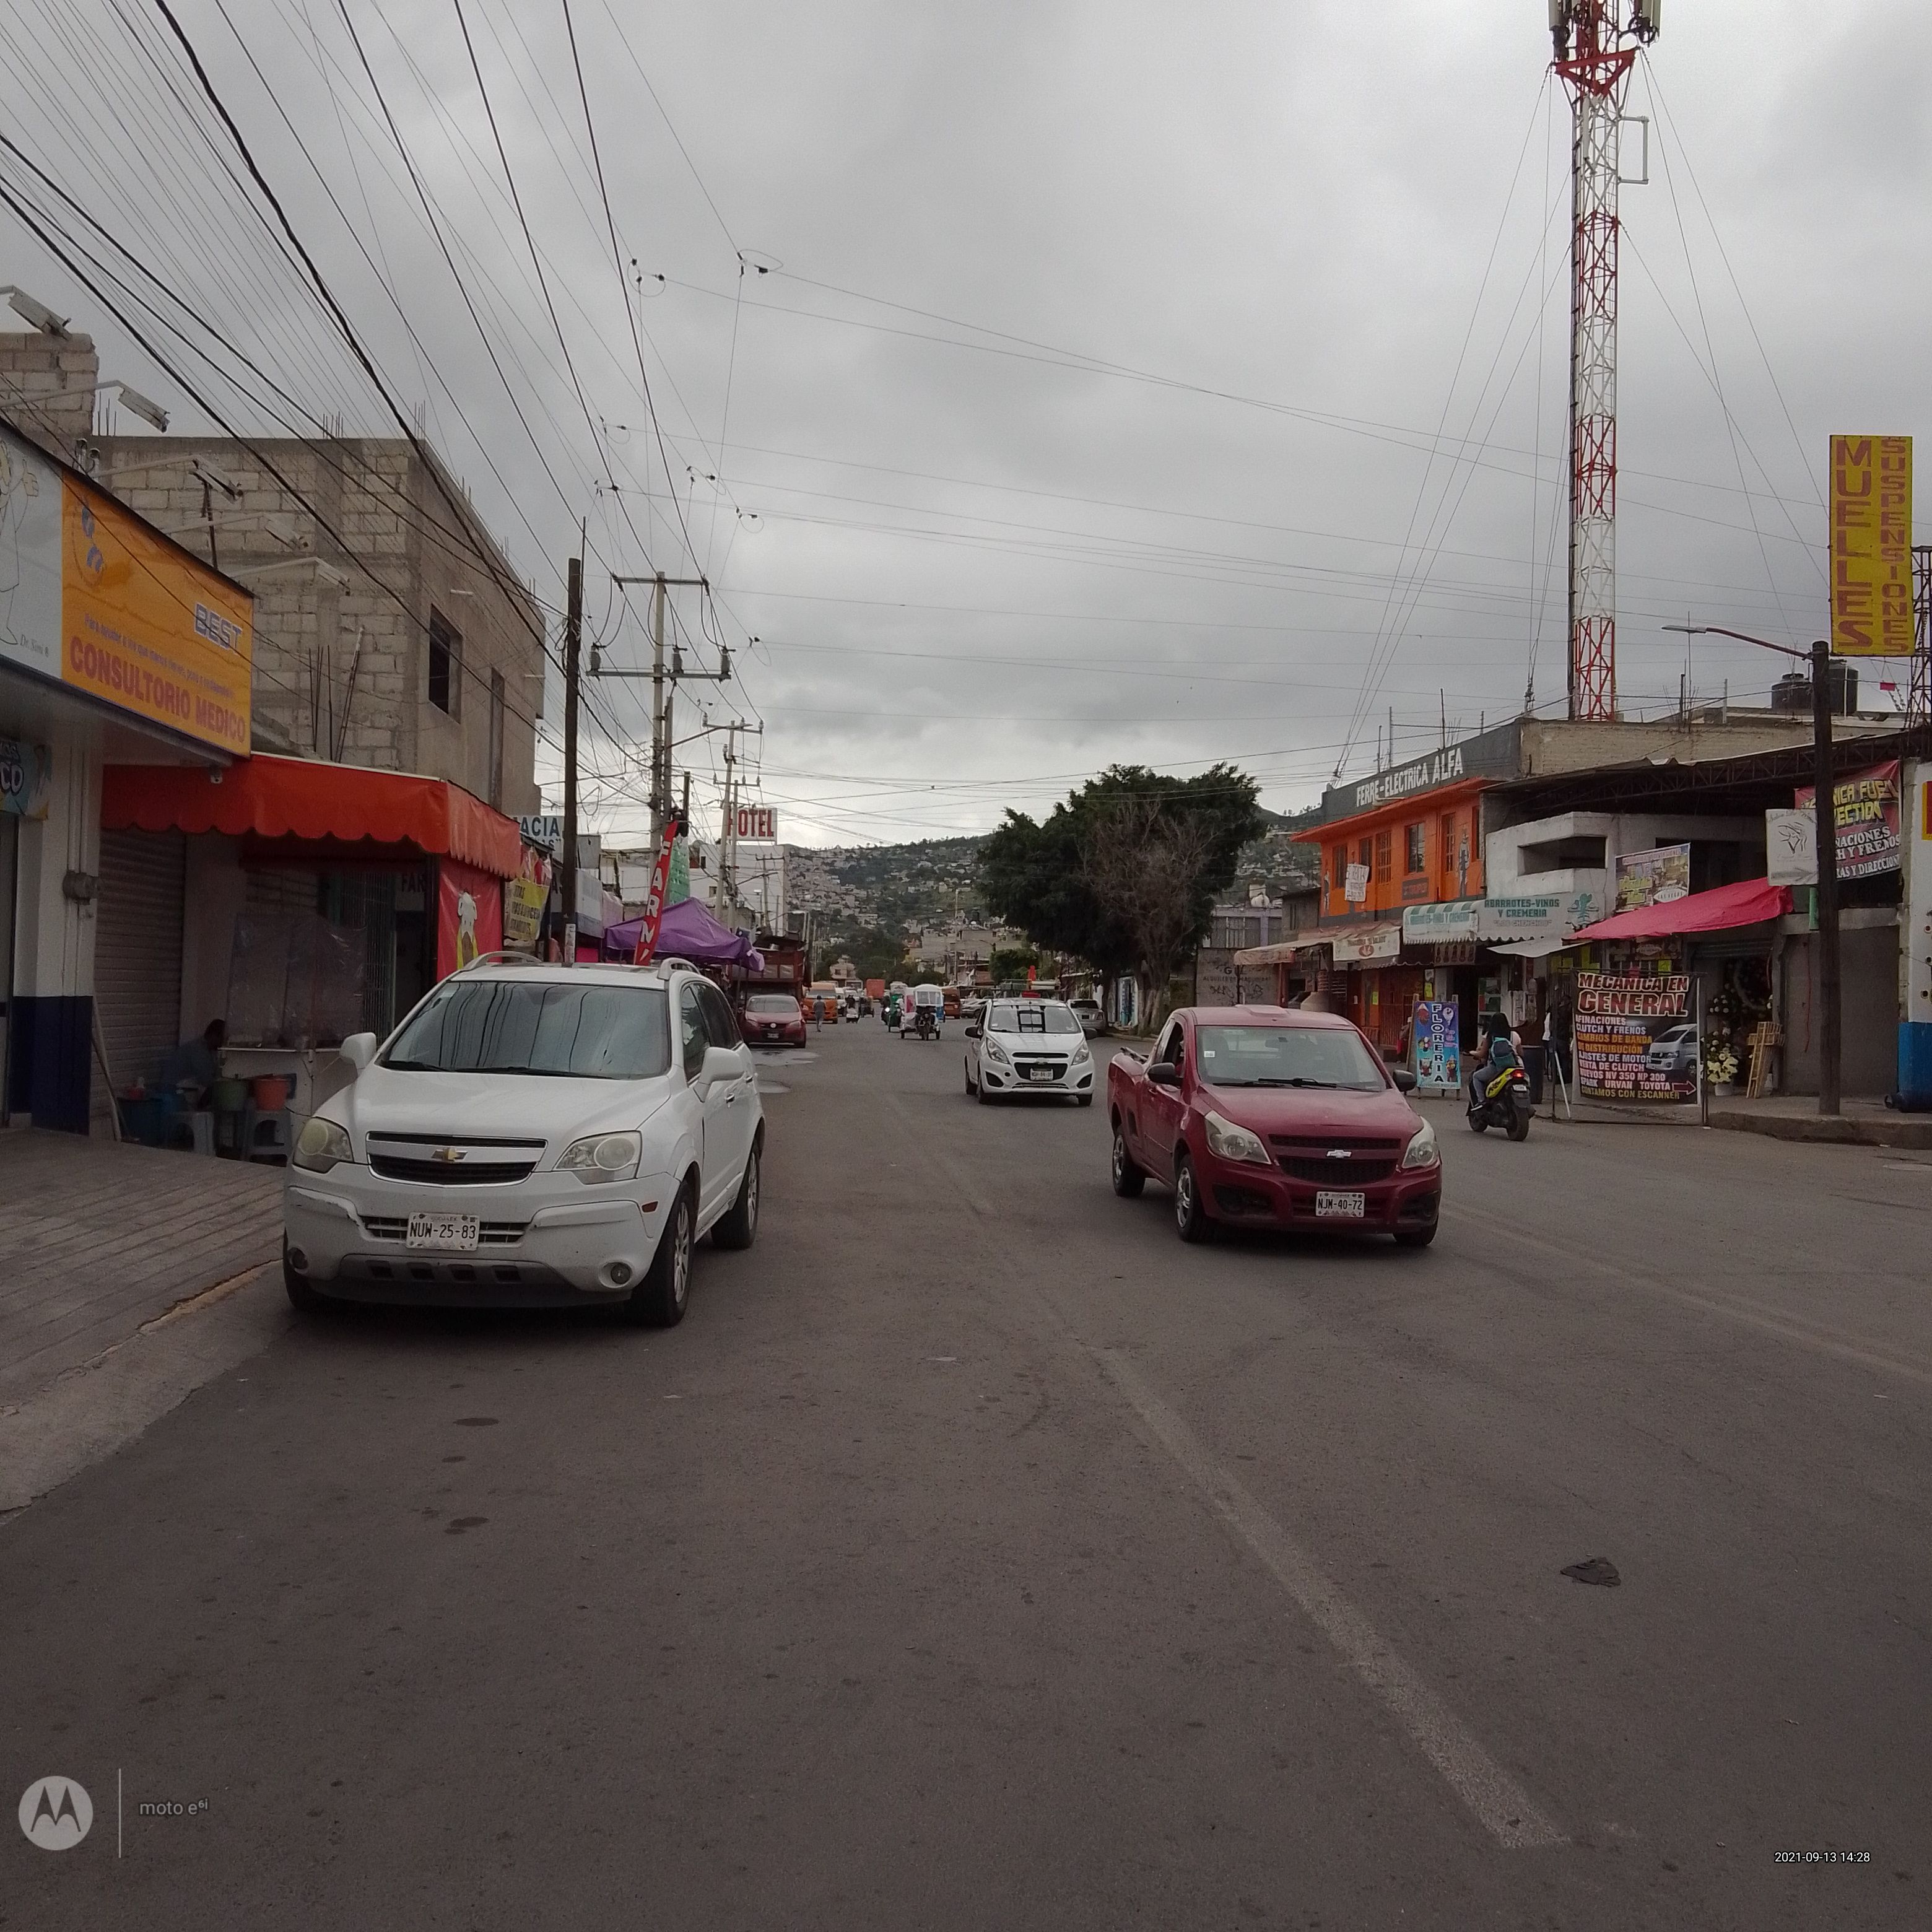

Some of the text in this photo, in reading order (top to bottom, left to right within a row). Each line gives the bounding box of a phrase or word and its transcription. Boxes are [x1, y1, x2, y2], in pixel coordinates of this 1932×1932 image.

[1836, 440, 1873, 648] MUELLES
[1880, 436, 1909, 652] SUSPENSIONES
[194, 602, 243, 655] BEST
[69, 635, 191, 720] CONSULTORIO
[195, 695, 245, 742] MEDICO
[1356, 747, 1464, 807] FERRE-ELECTRICA ALFA
[1834, 801, 1884, 826] ECTION
[729, 809, 774, 837] OTEL
[1847, 846, 1856, 859] Y
[1850, 864, 1858, 877] Y
[1497, 908, 1547, 918] Y CREMERIA
[1577, 972, 1689, 992] MECANICA EN
[1578, 989, 1689, 1017] GENERAL
[1576, 1024, 1647, 1035] CLUTCH Y FRENOS
[1431, 1004, 1445, 1082] FLORERIA
[1612, 1034, 1624, 1043] DE
[1625, 1035, 1653, 1044] BANDA
[1608, 1053, 1621, 1063] DE
[1622, 1053, 1651, 1063] MOTOR
[1598, 1061, 1610, 1071] DE
[1611, 1061, 1645, 1072] CLUTCH
[1605, 1071, 1617, 1080] NV
[1619, 1071, 1635, 1081] 350
[1637, 1073, 1648, 1081] NP
[1650, 1073, 1666, 1081] 300
[1604, 1079, 1633, 1090] URVAN
[1640, 1081, 1671, 1090] TOYOTA
[1617, 1089, 1635, 1099] CON
[1637, 1090, 1680, 1100] ESCANNER
